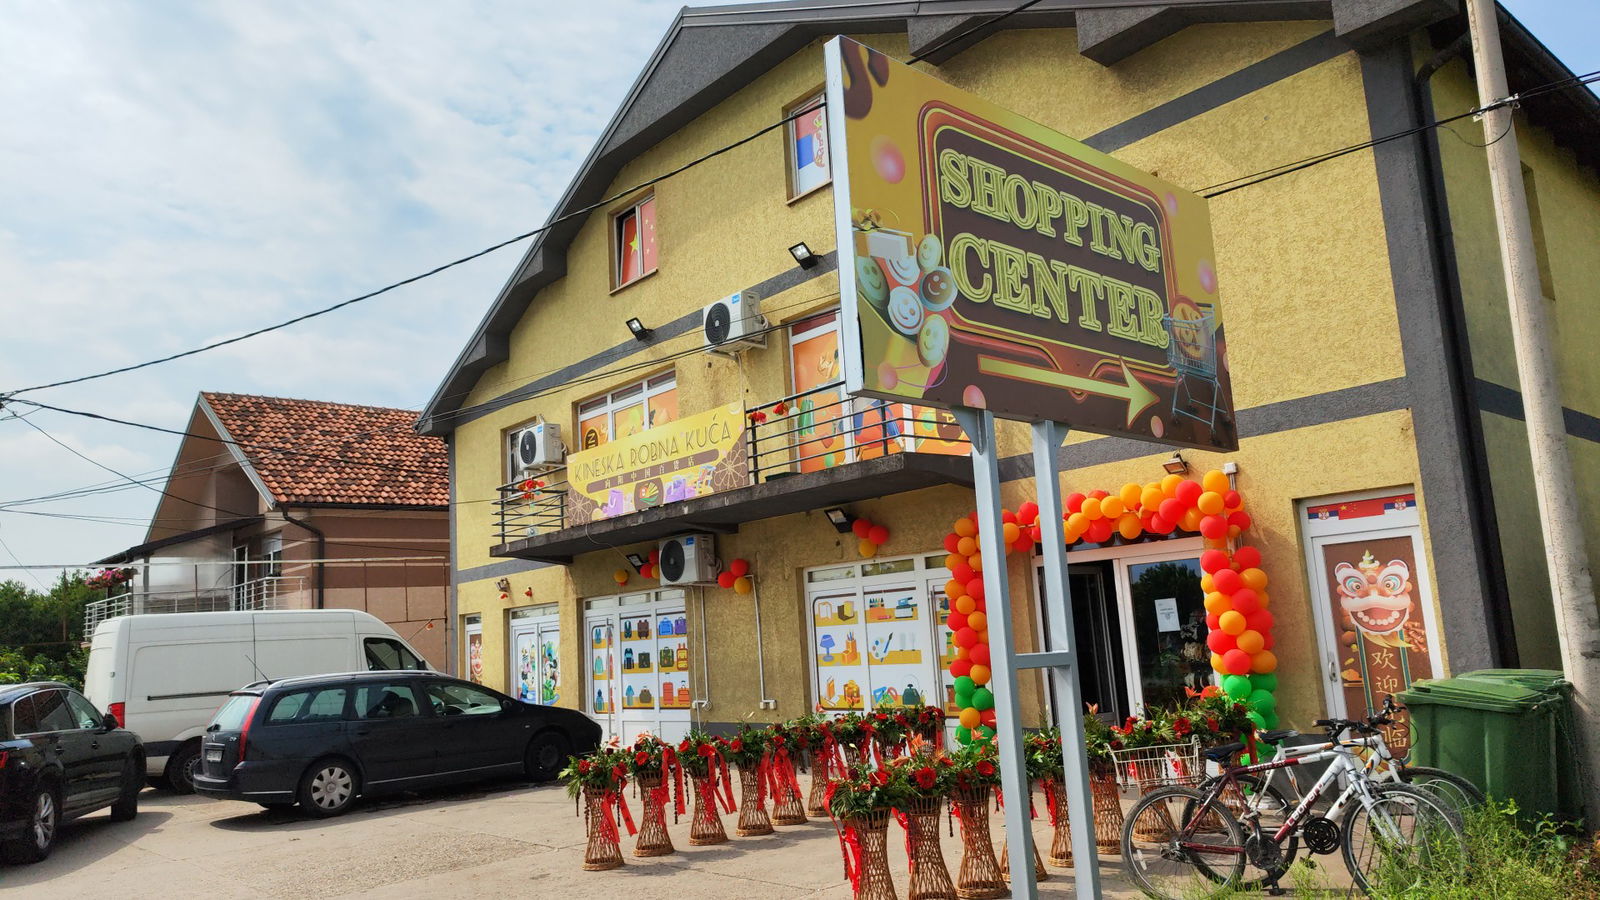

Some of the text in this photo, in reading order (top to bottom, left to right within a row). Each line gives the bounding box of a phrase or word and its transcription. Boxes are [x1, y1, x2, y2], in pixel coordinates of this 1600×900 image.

[939, 148, 1161, 273] SHOPPING
[949, 231, 1170, 350] CENTER
[574, 455, 625, 482] KINESKA
[630, 436, 680, 467] ROBNA
[685, 415, 732, 454] KUĆA
